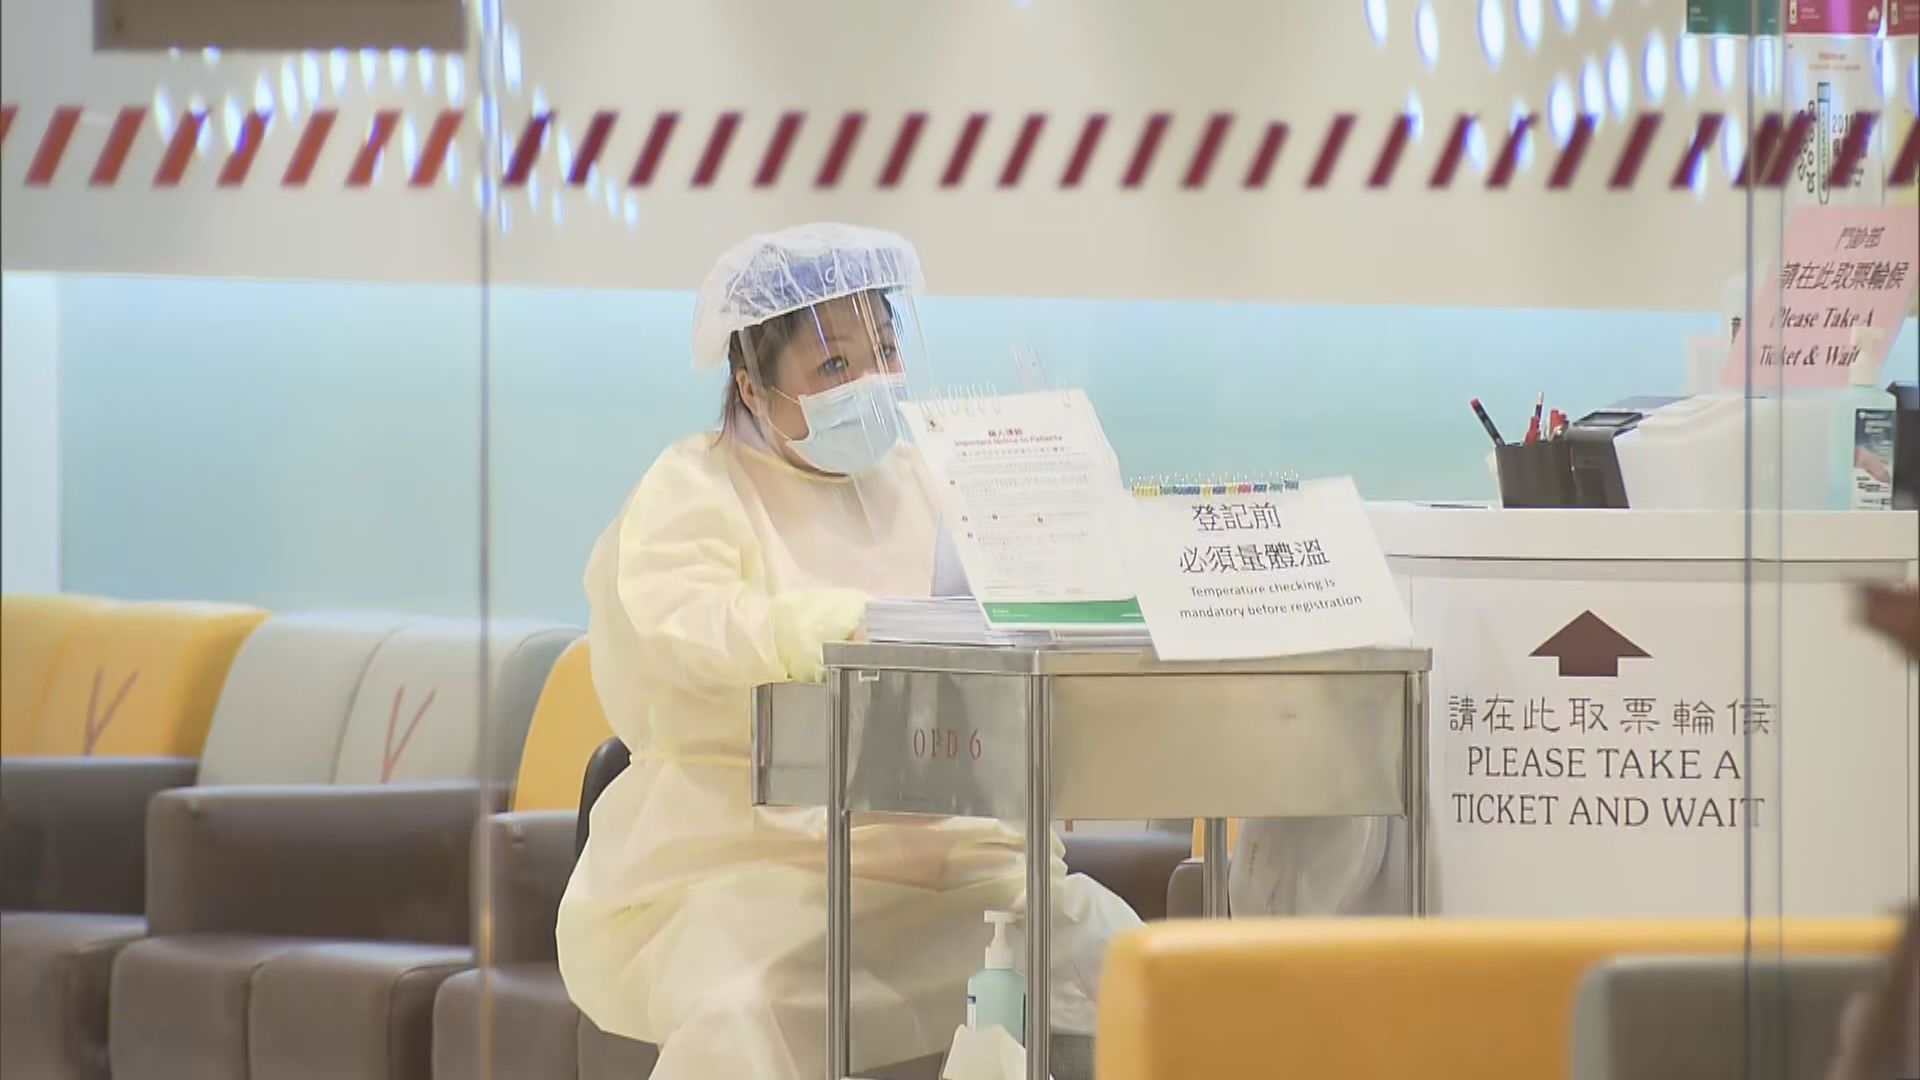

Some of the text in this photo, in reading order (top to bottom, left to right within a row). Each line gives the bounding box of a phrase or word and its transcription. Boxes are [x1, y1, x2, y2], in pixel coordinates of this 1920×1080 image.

[1771, 307, 1874, 329] Please Take A
[1759, 344, 1861, 367] Ticket & Wait
[1192, 502, 1282, 531] 登記前
[1179, 538, 1330, 573] 必須量體溫
[1190, 577, 1335, 599] Temperature checking is
[1179, 594, 1362, 619] mandatory before registration
[1448, 693, 1776, 735] 請在此取票輪候
[913, 728, 982, 760] OPD 6
[1467, 746, 1742, 779] PLEASE TAKE A
[1452, 793, 1765, 828] TICKET AND WAIT
